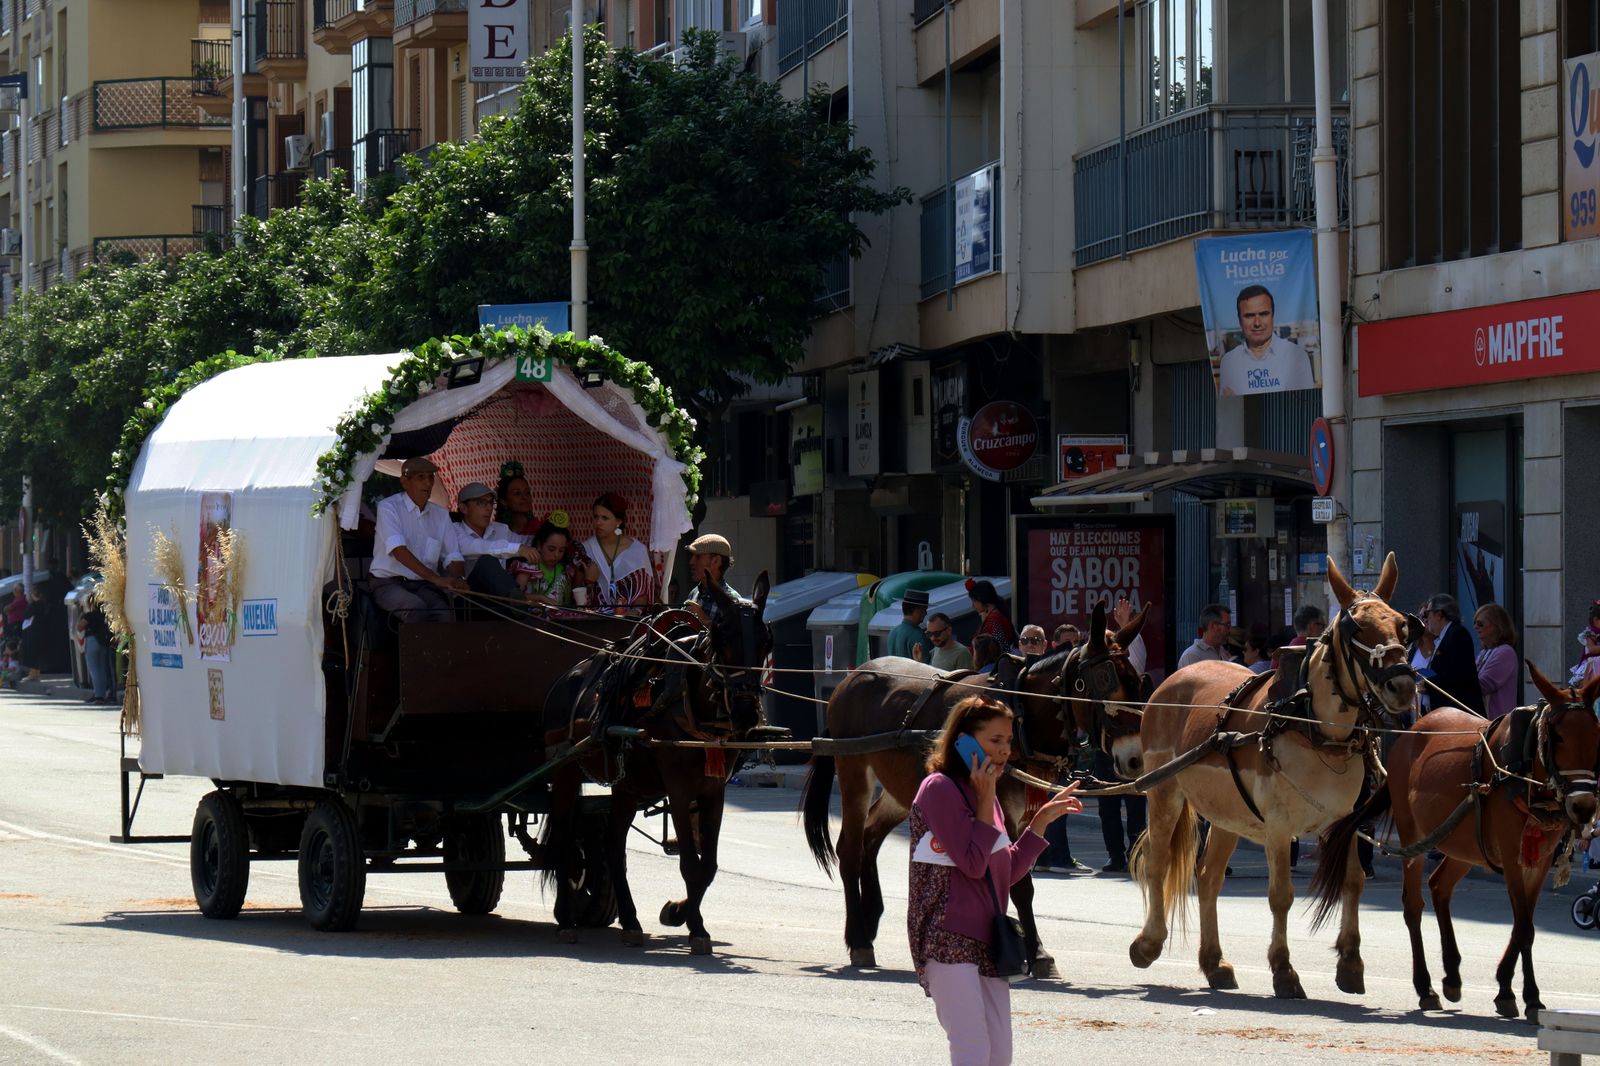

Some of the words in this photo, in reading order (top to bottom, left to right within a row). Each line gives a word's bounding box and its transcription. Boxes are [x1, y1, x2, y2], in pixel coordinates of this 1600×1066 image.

[1571, 188, 1596, 228] 959
[1220, 247, 1267, 263] Lucha
[1269, 250, 1289, 263] por
[1225, 262, 1285, 279] Huelva
[498, 313, 532, 325] Lucha
[1488, 315, 1564, 365] MAPFRE
[520, 357, 546, 379] 48
[1247, 368, 1269, 380] POR
[1248, 377, 1280, 389] HUELVA
[973, 433, 1036, 451] Cruzcampo
[1050, 531, 1071, 546] HAY
[1073, 531, 1141, 545] ELECCIONES
[1050, 546, 1067, 556] QUE
[1069, 546, 1096, 556] DEJAN
[1098, 546, 1116, 555] MUY
[1118, 545, 1141, 555] BUEN
[1051, 557, 1140, 589] SABOR
[1051, 589, 1079, 615] DE
[149, 608, 156, 625] LA
[156, 607, 178, 626] BLANCA
[243, 603, 276, 631] HUELVA
